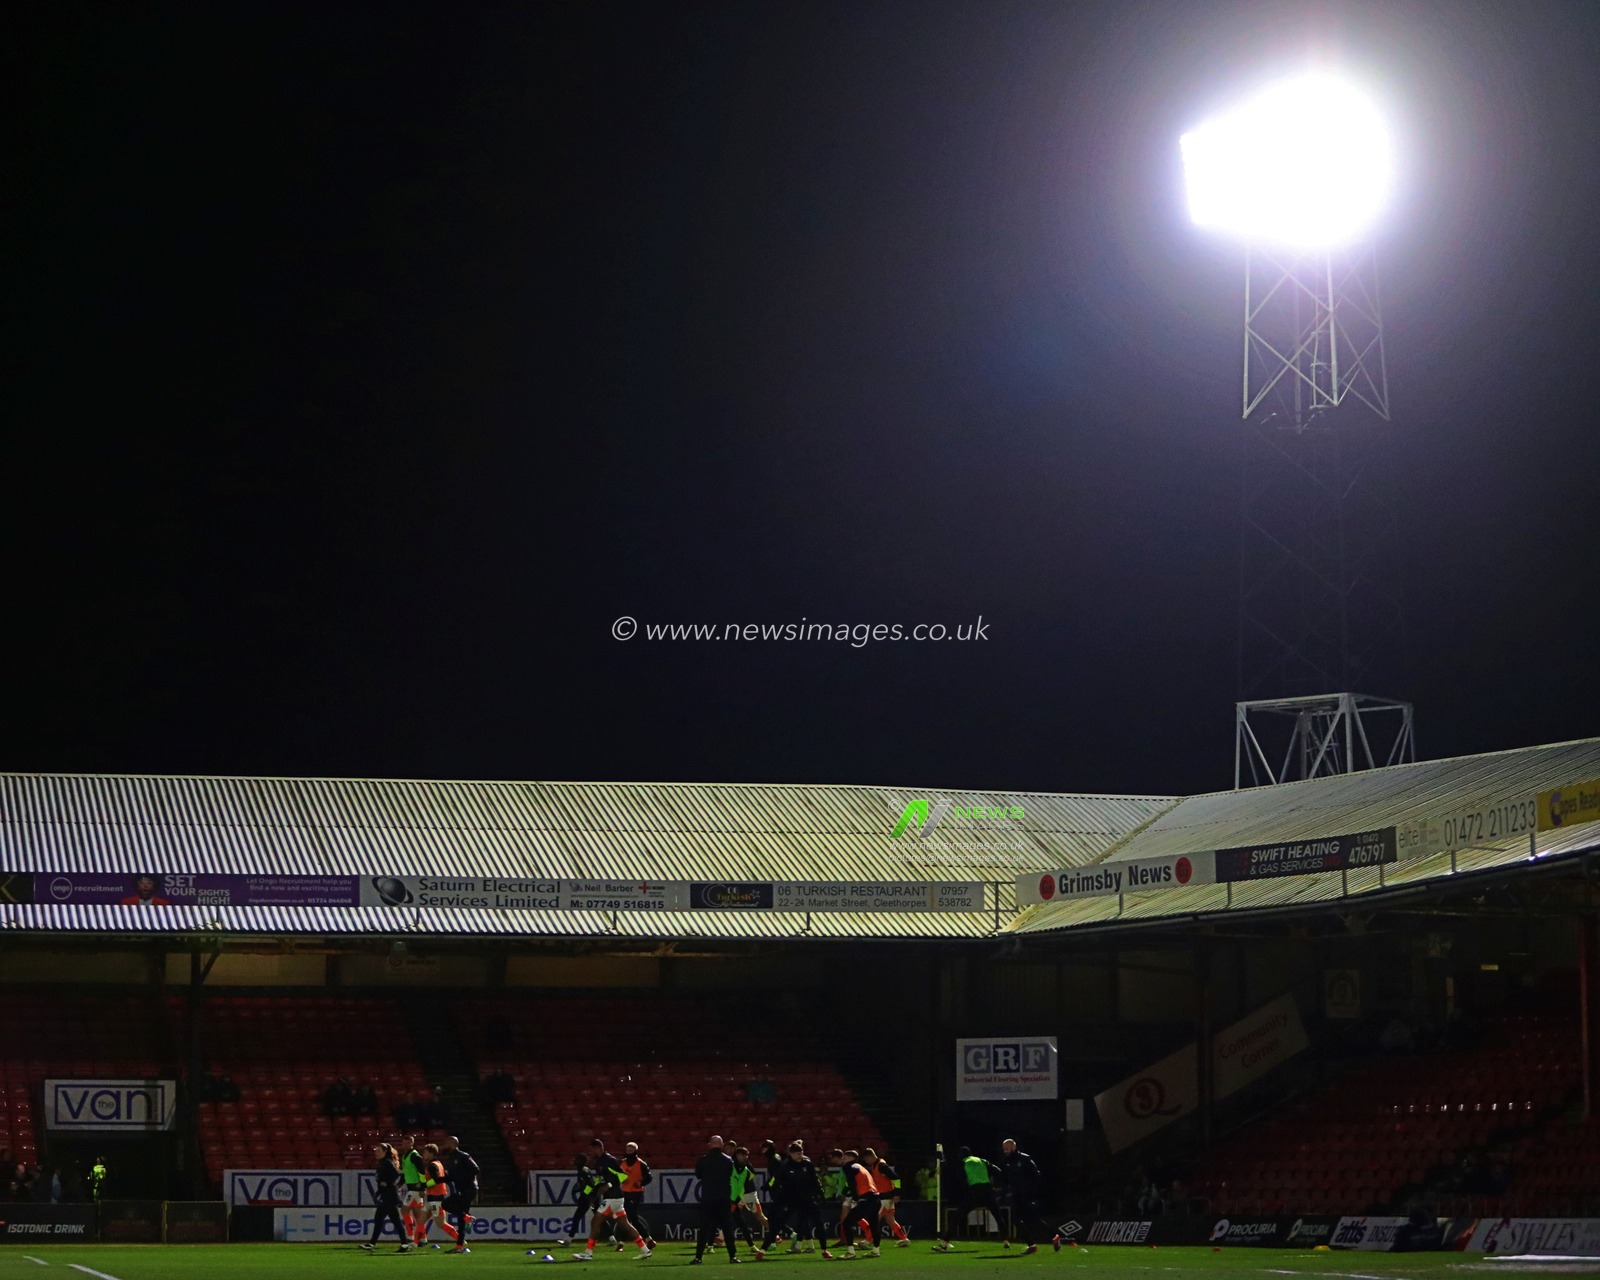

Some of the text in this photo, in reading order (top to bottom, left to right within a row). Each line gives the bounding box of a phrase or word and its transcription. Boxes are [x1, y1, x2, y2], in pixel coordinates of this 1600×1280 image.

[1444, 813, 1483, 846] 01472
[1489, 801, 1536, 837] 211233
[1251, 841, 1340, 863] SWIFT HEATING
[1250, 866, 1256, 875] &
[1259, 862, 1279, 874] GAS
[1280, 857, 1323, 873] SERVICES
[164, 875, 196, 887] SET
[419, 878, 561, 893] Saturn Electrical
[1059, 868, 1122, 894] Grimsby
[1128, 864, 1172, 886] News
[164, 888, 196, 896] YOUR
[584, 884, 634, 892] Neil Barber
[778, 886, 927, 896] 06 TURKISH RESTAURANT
[941, 886, 968, 896] 07957
[198, 897, 230, 905] HIGH!
[419, 893, 560, 908] Services Limited
[570, 900, 664, 909] M: 07749 516815
[778, 898, 805, 907] 22-24
[808, 899, 838, 907] Market
[874, 898, 927, 909] Cleethorpes
[938, 898, 972, 907] 538782
[1219, 1012, 1289, 1060] Community
[966, 1047, 1045, 1071] GRF
[1241, 1037, 1280, 1068] Corner
[62, 1090, 152, 1120] van
[238, 1178, 330, 1205] van
[275, 1187, 291, 1198] the
[8, 1223, 85, 1233] ISOTONIC DRINK
[447, 1214, 586, 1234] ectrical
[1227, 1223, 1277, 1235] PROCURIA
[1086, 1221, 1140, 1243] KITLOCKER
[1504, 1222, 1581, 1250] SWALES
